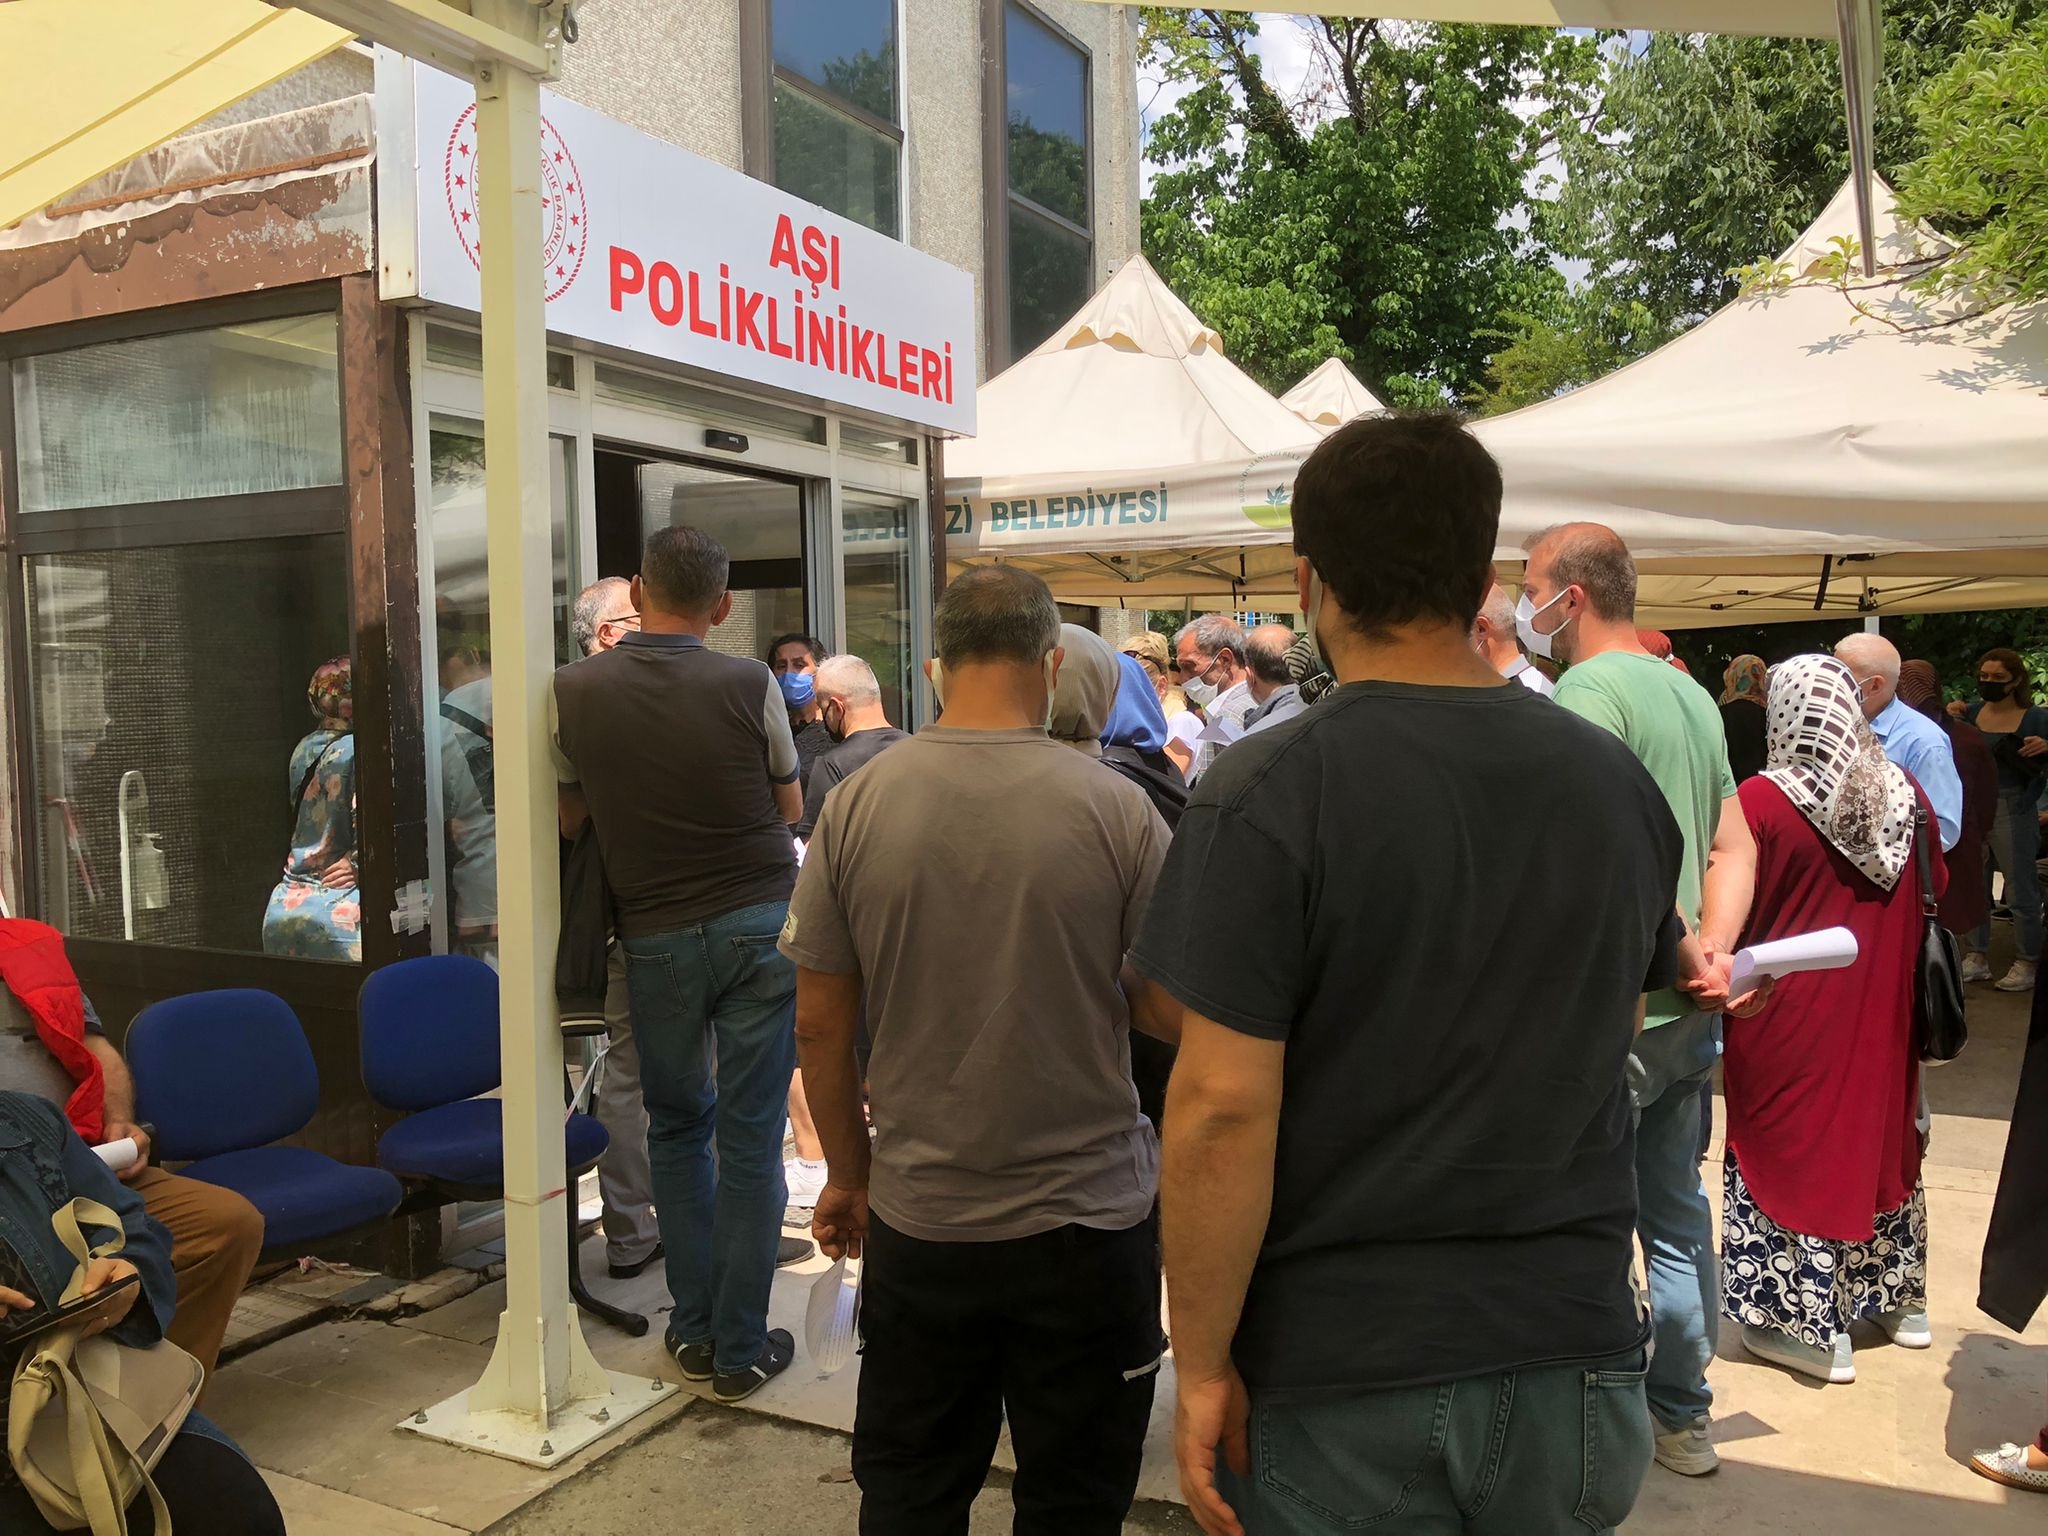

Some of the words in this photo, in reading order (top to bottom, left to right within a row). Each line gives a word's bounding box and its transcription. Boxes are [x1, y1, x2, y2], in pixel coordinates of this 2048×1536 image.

[770, 213, 841, 299] AŞI
[609, 245, 954, 405] POLİKLİNİKLERİ
[990, 481, 1168, 532] BELEDİYESİ
